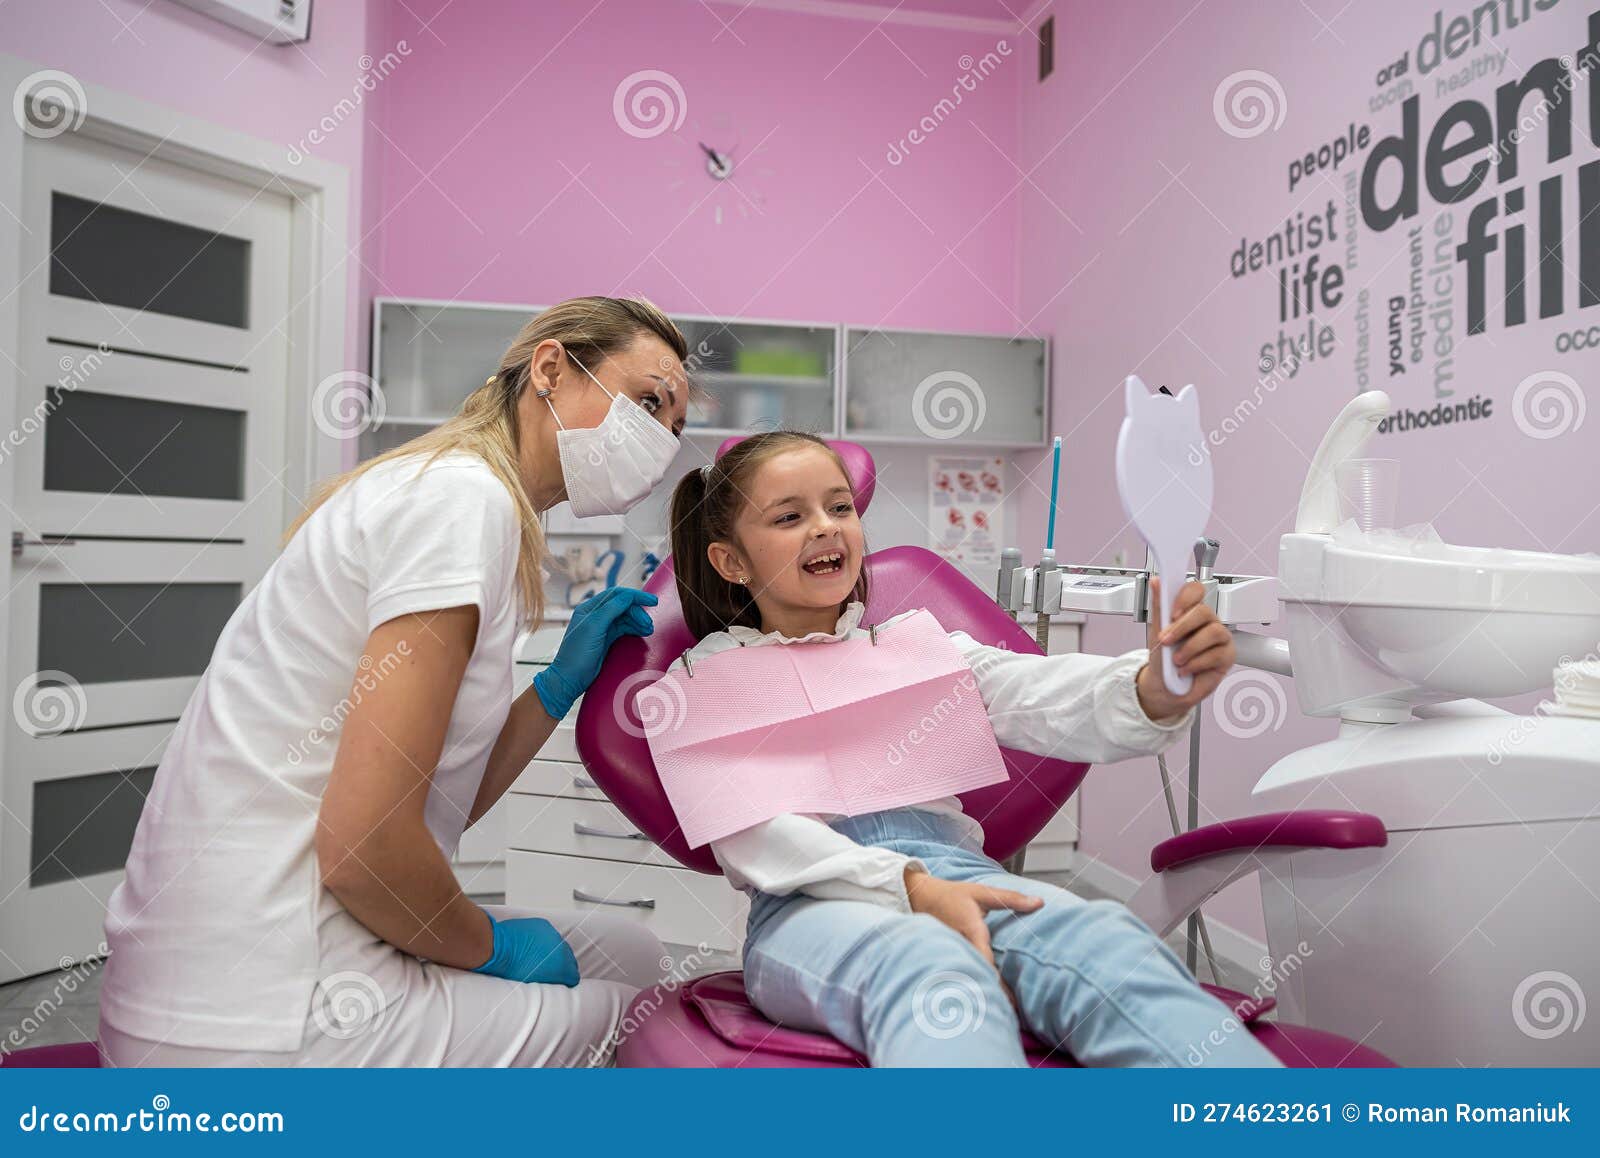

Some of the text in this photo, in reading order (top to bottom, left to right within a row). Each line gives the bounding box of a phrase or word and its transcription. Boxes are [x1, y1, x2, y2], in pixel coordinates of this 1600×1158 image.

[1368, 79, 1413, 113] tooth
[1376, 51, 1409, 87] oral
[1435, 48, 1509, 98] healthy
[1288, 123, 1371, 192] people
[1230, 200, 1338, 279] dentist
[1344, 170, 1358, 270] medical
[1279, 254, 1345, 323] life
[1407, 226, 1427, 363] equipment
[1430, 211, 1455, 399] medicine
[1258, 320, 1335, 379] style
[1389, 295, 1406, 377] young
[1377, 395, 1493, 434] orthodontic
